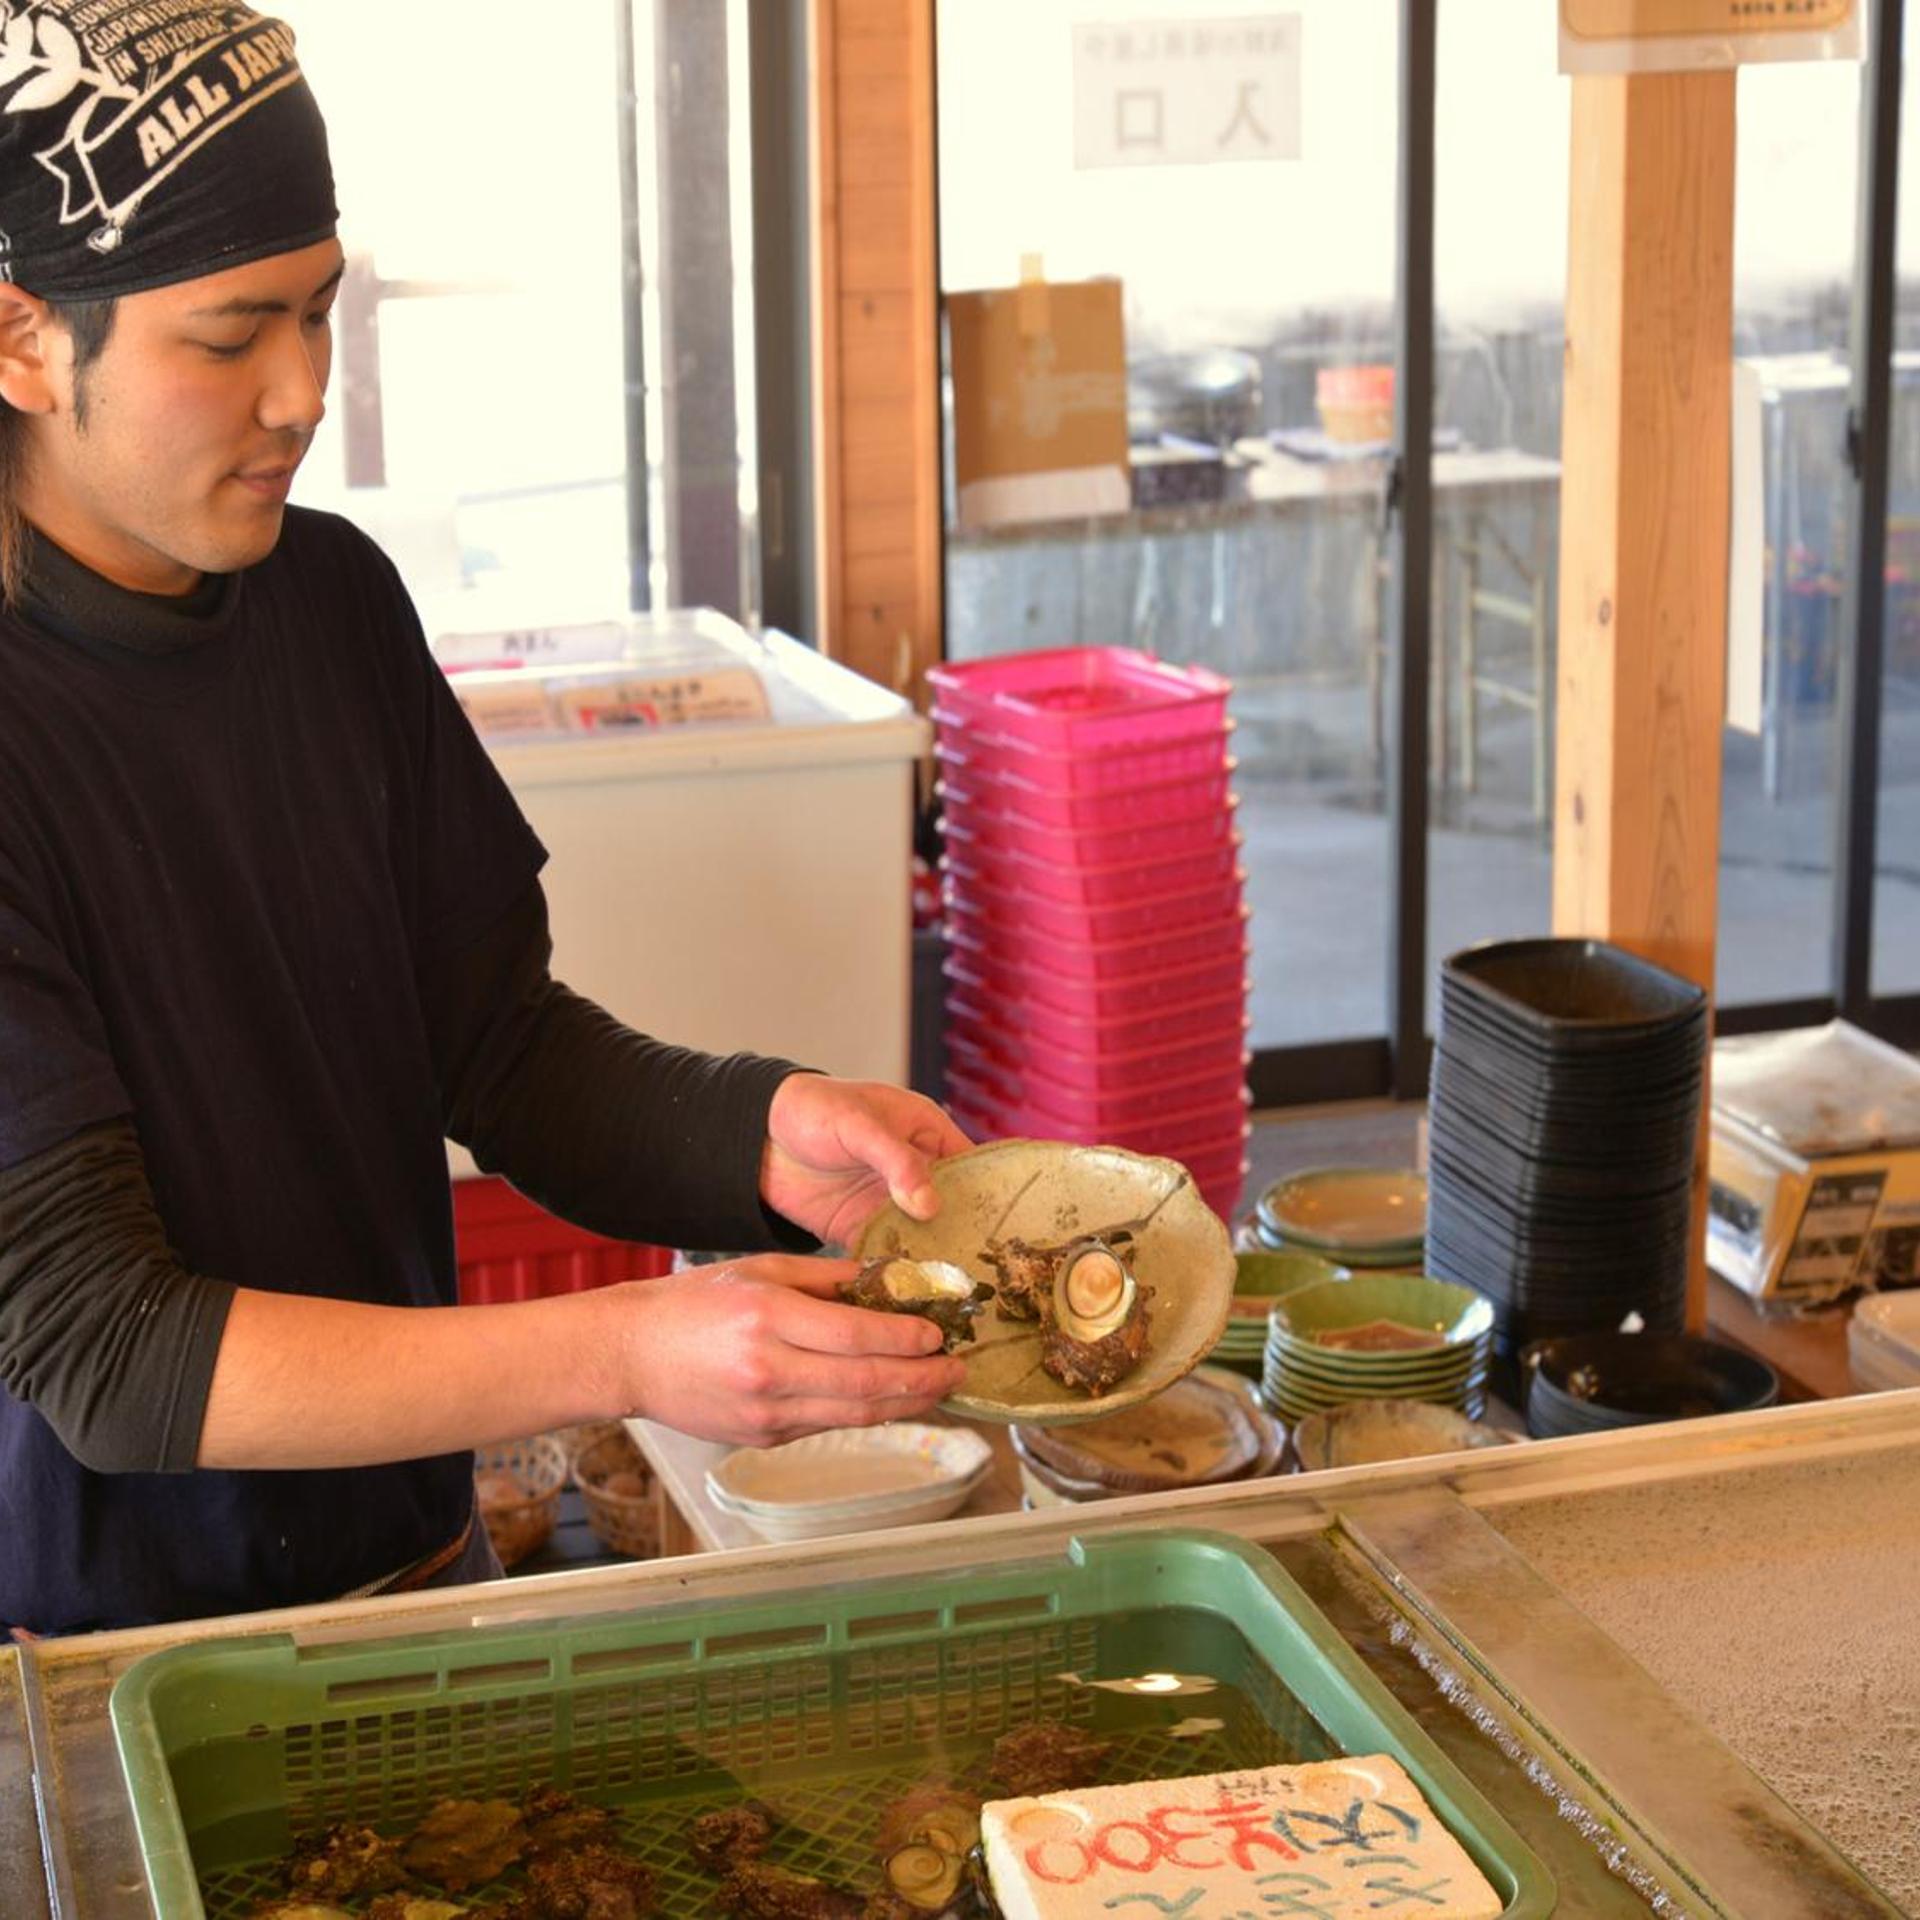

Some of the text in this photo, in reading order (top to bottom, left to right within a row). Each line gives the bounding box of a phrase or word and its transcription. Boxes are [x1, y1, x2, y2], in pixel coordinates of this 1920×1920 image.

[109, 14, 227, 82] IN SHIZUOKA
[136, 23, 296, 168] ALL JAPA
